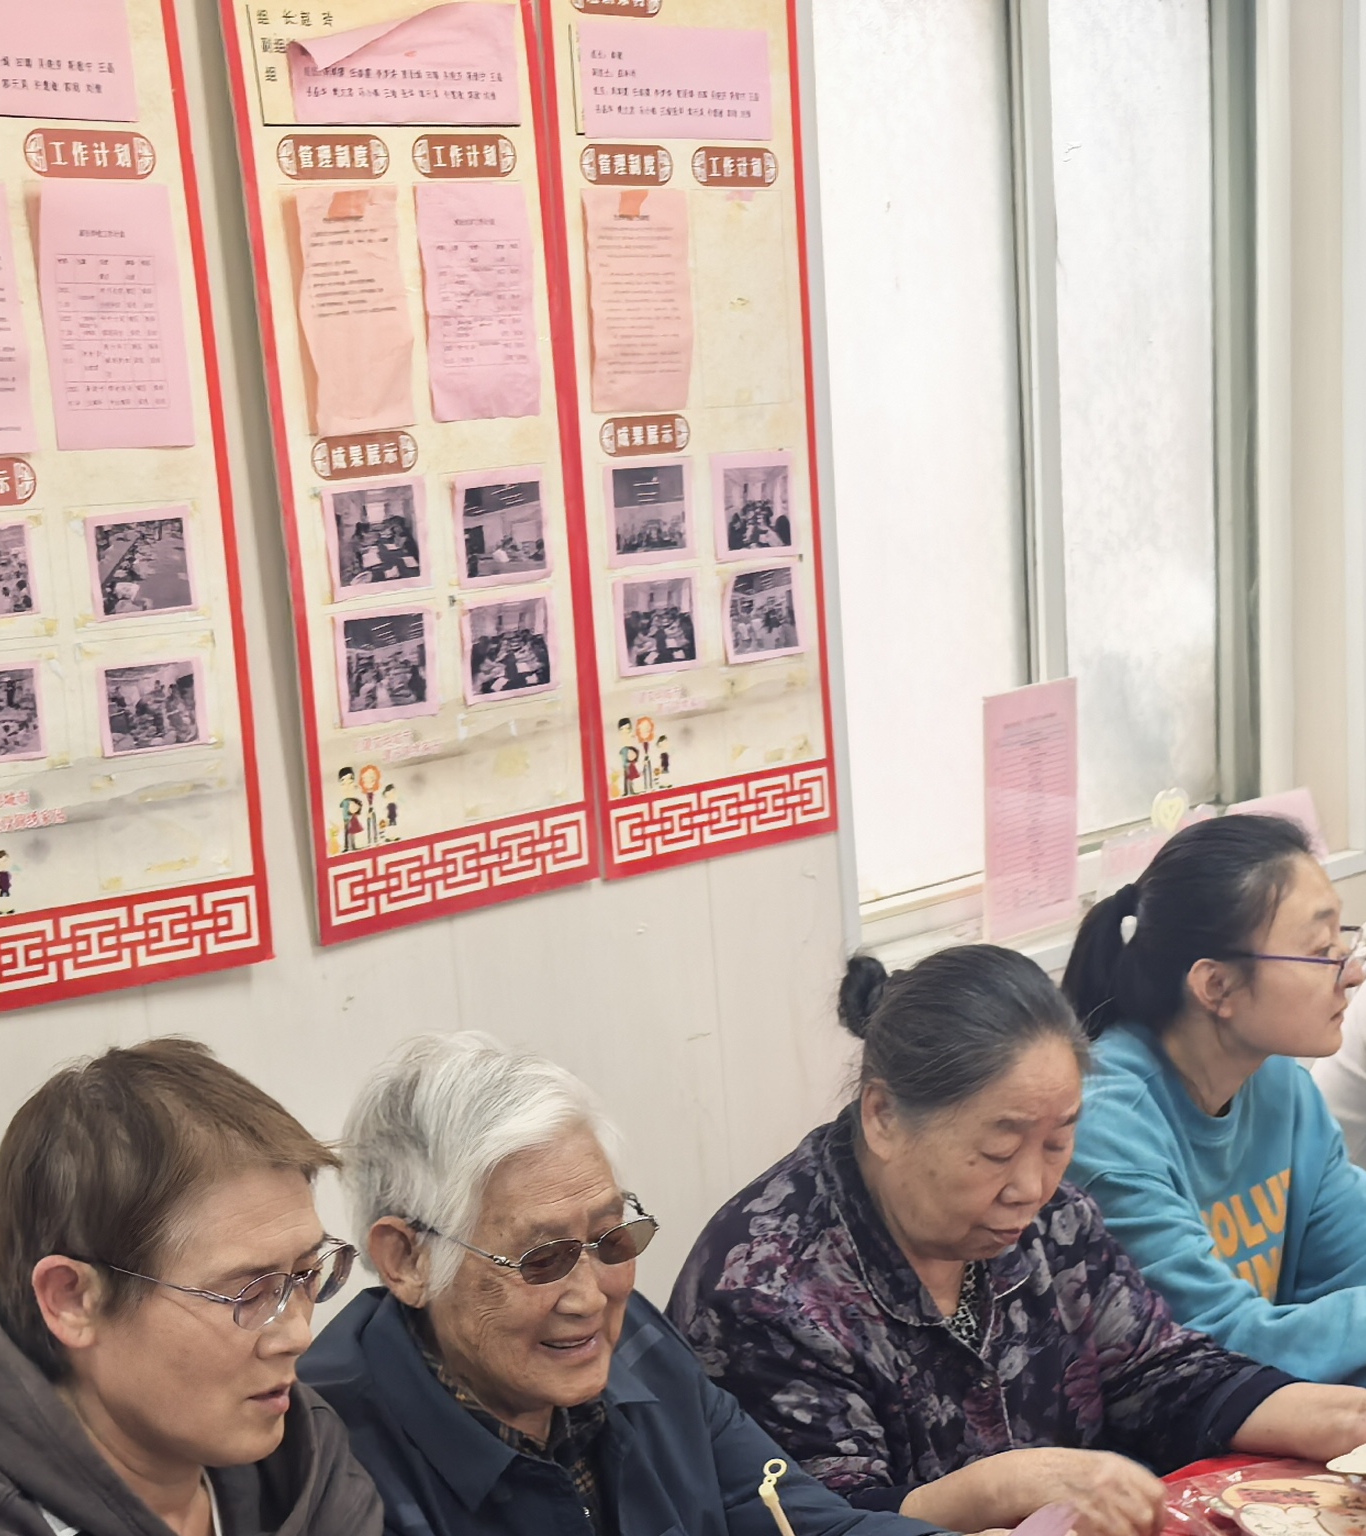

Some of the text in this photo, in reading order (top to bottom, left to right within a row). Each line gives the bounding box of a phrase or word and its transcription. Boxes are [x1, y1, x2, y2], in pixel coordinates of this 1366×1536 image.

[49, 139, 132, 168] 工作计划
[298, 144, 371, 169] 管理制度
[431, 144, 499, 168] 工作计划
[332, 439, 398, 468] 成果展示
[1201, 1168, 1291, 1260] OLU
